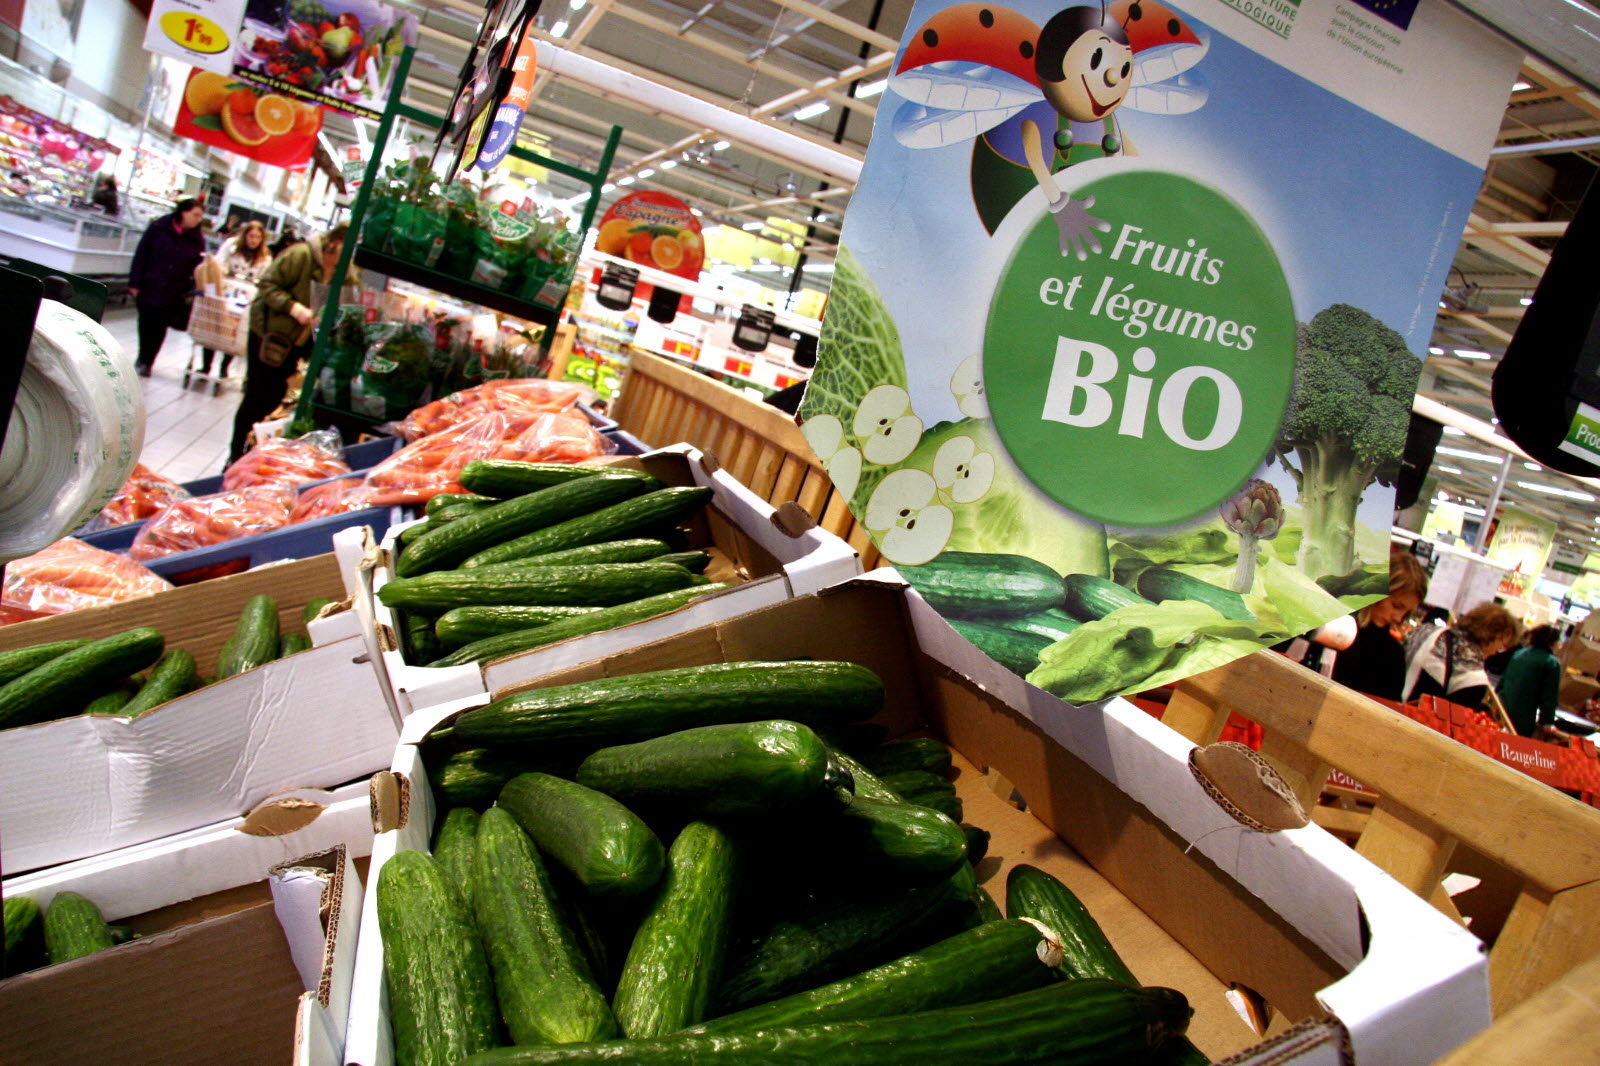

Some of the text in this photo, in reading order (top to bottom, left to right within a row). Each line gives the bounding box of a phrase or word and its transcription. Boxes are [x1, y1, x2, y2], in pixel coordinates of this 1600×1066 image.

[1110, 223, 1224, 285] Fruits
[1039, 275, 1257, 351] et légumes
[1041, 335, 1243, 451] BiO
[1500, 742, 1557, 770] Rougeline
